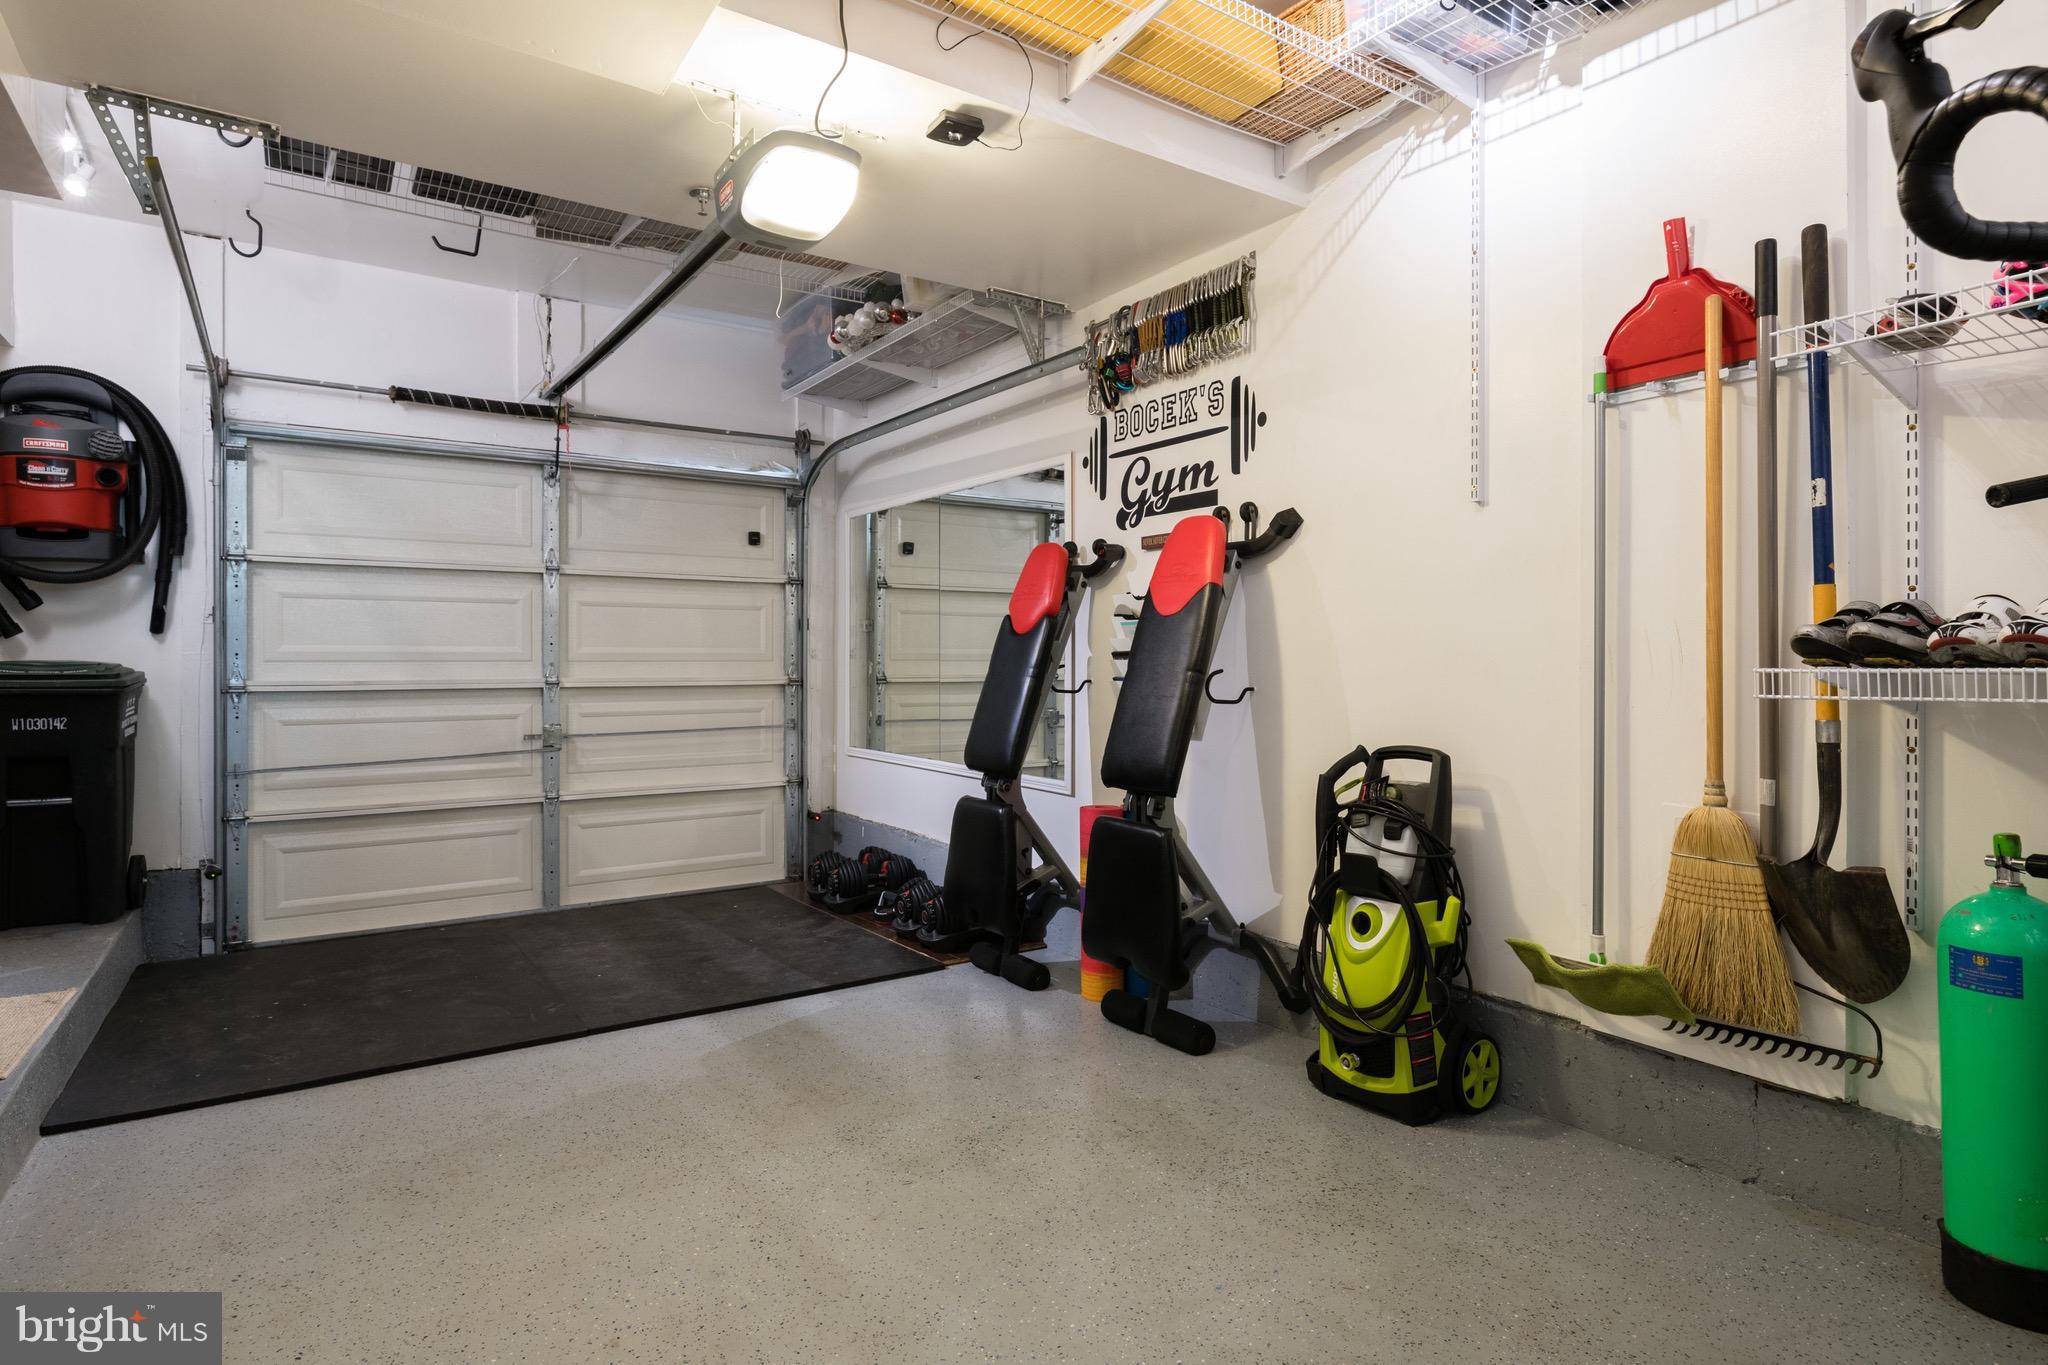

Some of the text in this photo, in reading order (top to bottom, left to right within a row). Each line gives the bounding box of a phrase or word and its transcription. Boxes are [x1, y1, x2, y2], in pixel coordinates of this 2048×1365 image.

[1114, 380, 1224, 442] BOCEK'S
[25, 440, 66, 448] CRAFTSMAN
[1121, 456, 1219, 528] Gym
[11, 717, 68, 730] W1030142
